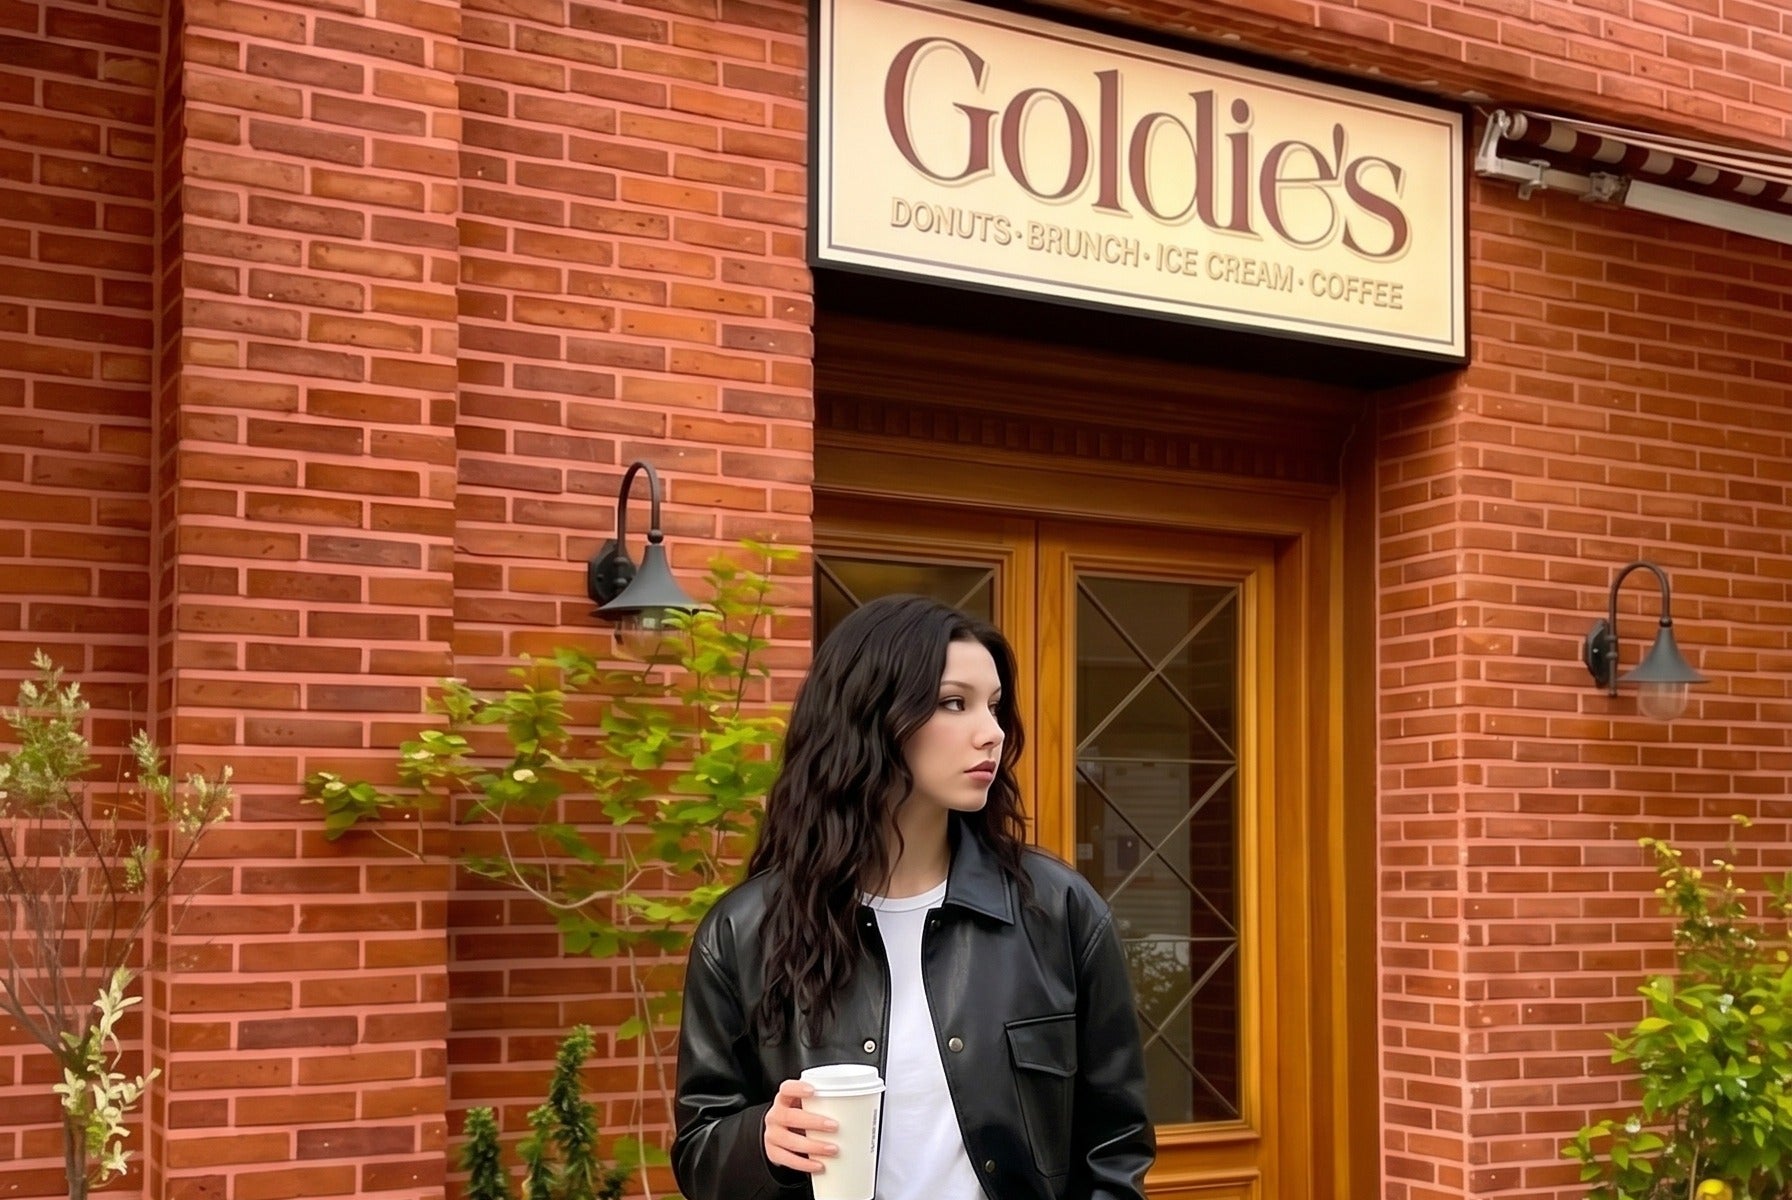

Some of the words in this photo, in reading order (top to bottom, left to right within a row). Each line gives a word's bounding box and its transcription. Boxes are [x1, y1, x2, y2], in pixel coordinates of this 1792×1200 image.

[884, 36, 1411, 259] Goldie's
[891, 197, 1011, 245] DONUTS
[1027, 219, 1141, 268] BRUNCH
[1156, 243, 1197, 277] ICE
[1206, 253, 1293, 294] CREAM
[1310, 268, 1403, 310] COFFEE
